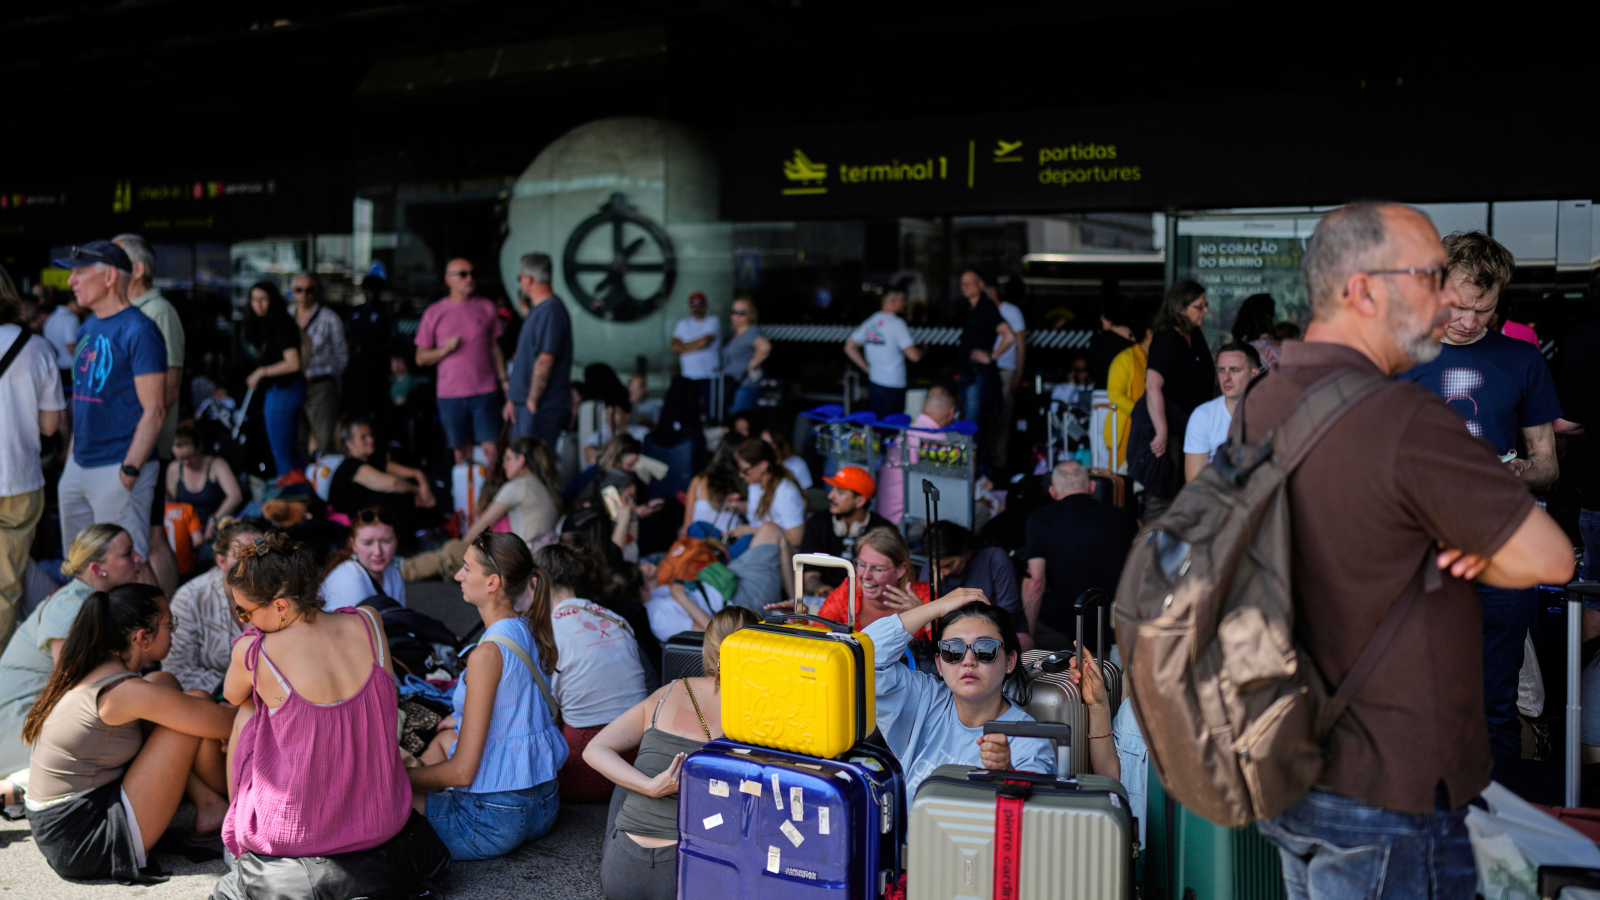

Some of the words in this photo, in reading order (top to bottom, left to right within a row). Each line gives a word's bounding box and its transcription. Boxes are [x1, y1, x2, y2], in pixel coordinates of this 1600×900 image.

[1038, 142, 1118, 166] partidas
[838, 158, 933, 184] terminal
[938, 155, 948, 180] 1
[1038, 165, 1142, 187] departures
[1198, 243, 1217, 255] NO
[1219, 241, 1277, 255] CORAÇÃO
[1198, 256, 1217, 268] DO
[1219, 256, 1263, 268] BAIRRO
[1003, 809, 1014, 851] pierre
[785, 867, 817, 876] AMERICAN
